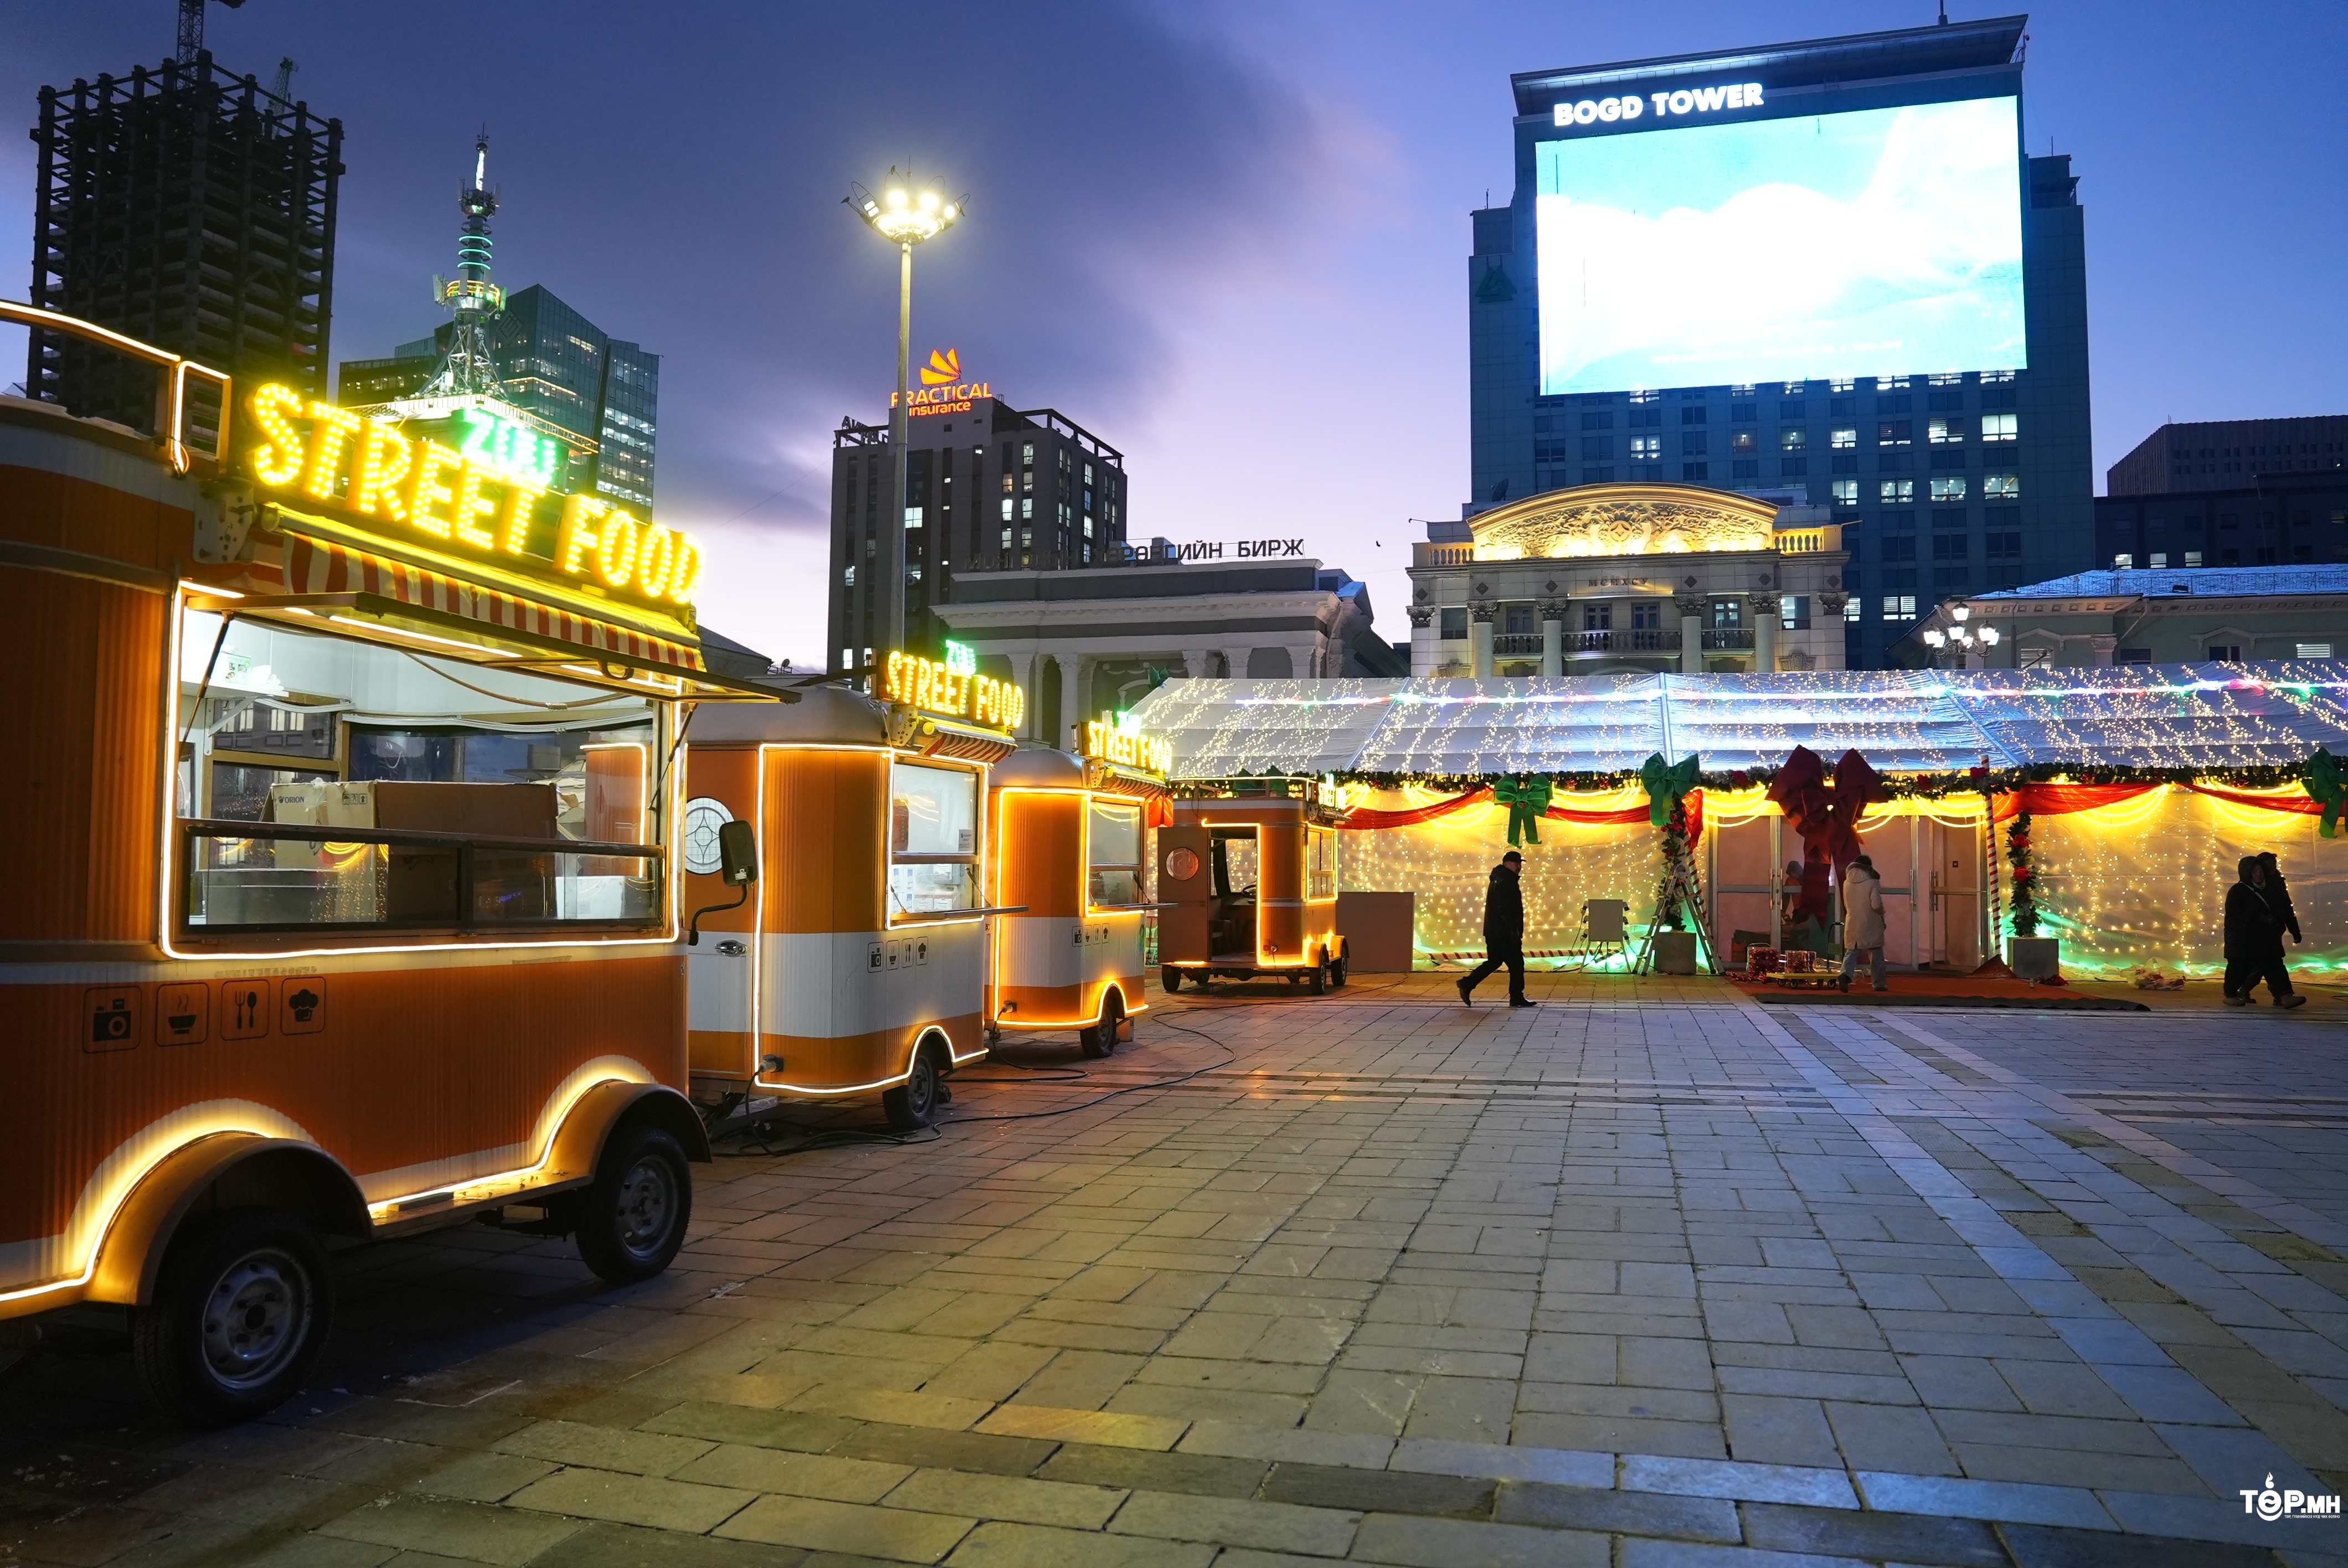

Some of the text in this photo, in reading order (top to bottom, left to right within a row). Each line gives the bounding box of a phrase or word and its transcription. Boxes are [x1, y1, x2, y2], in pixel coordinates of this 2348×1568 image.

[1554, 82, 1764, 126] BOGD TOWER
[253, 381, 706, 605] STREET FOOD
[1238, 539, 1304, 558] БИРЖ
[1588, 577, 1649, 587] MCMXCV
[887, 651, 1024, 728] STREET FOOD
[1088, 720, 1137, 766] STREET
[1140, 735, 1173, 773] FOOD
